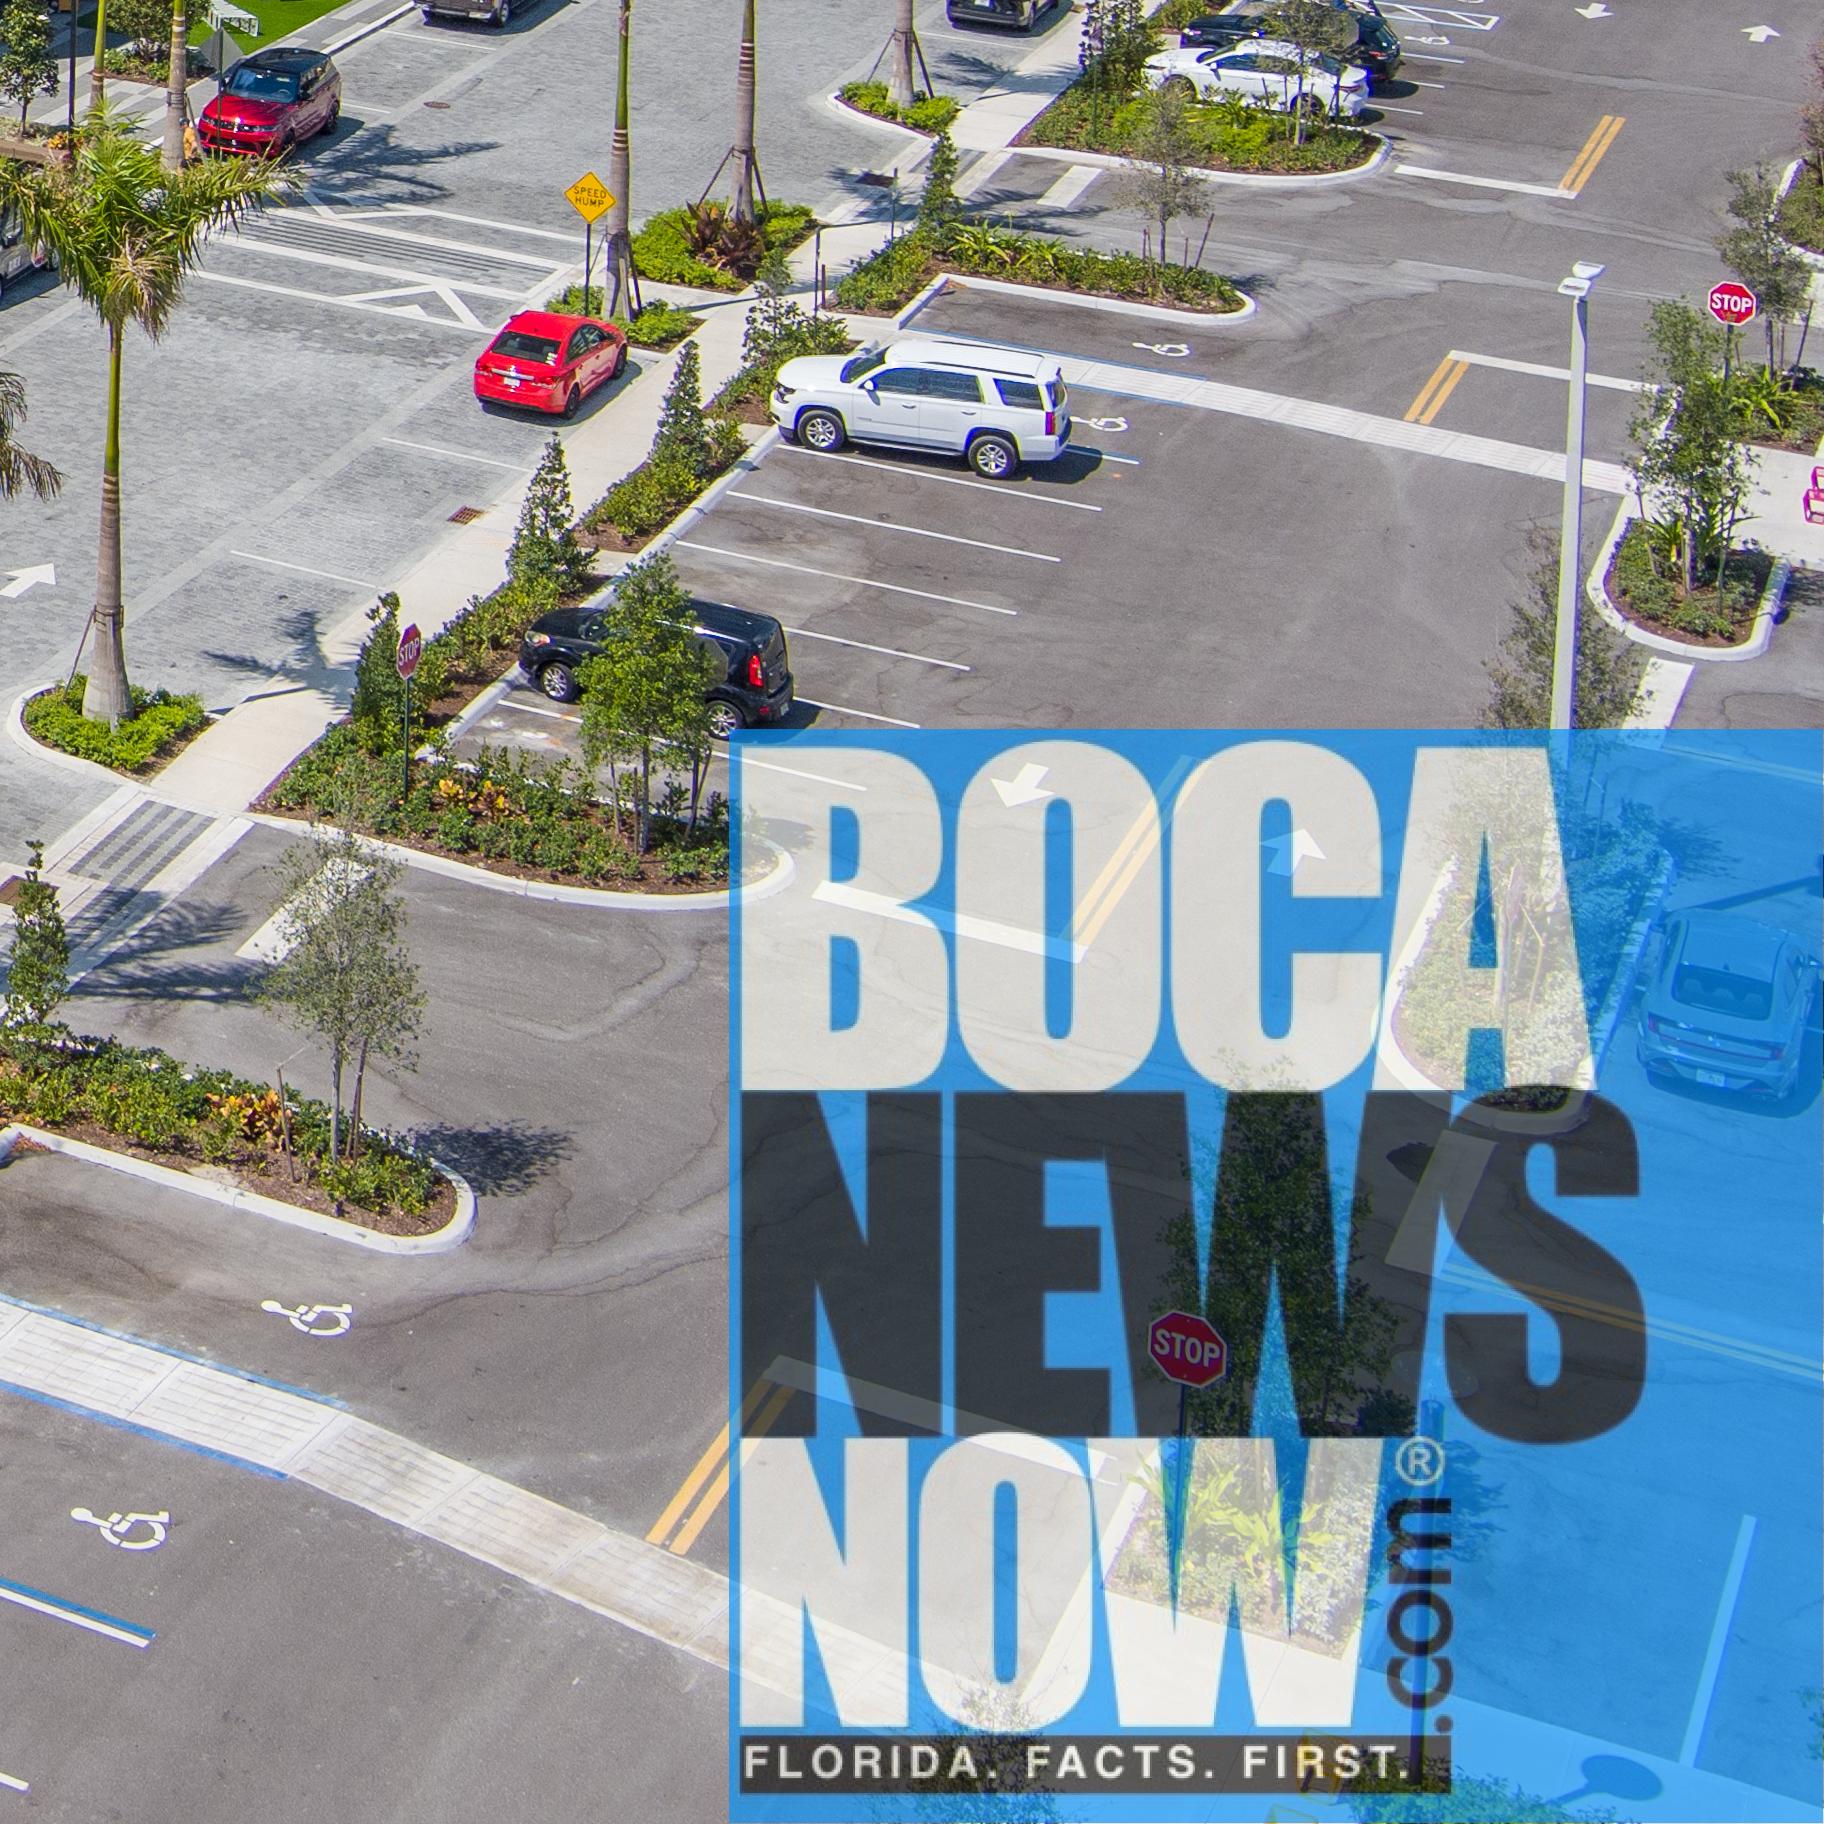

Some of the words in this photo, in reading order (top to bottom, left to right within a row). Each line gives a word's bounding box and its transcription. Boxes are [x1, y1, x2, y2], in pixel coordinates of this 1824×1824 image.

[573, 185, 607, 200] SPEED
[575, 196, 605, 208] HUMP
[1712, 293, 1752, 313] STOP
[398, 636, 420, 666] STOP
[1153, 1328, 1221, 1368] STOP
